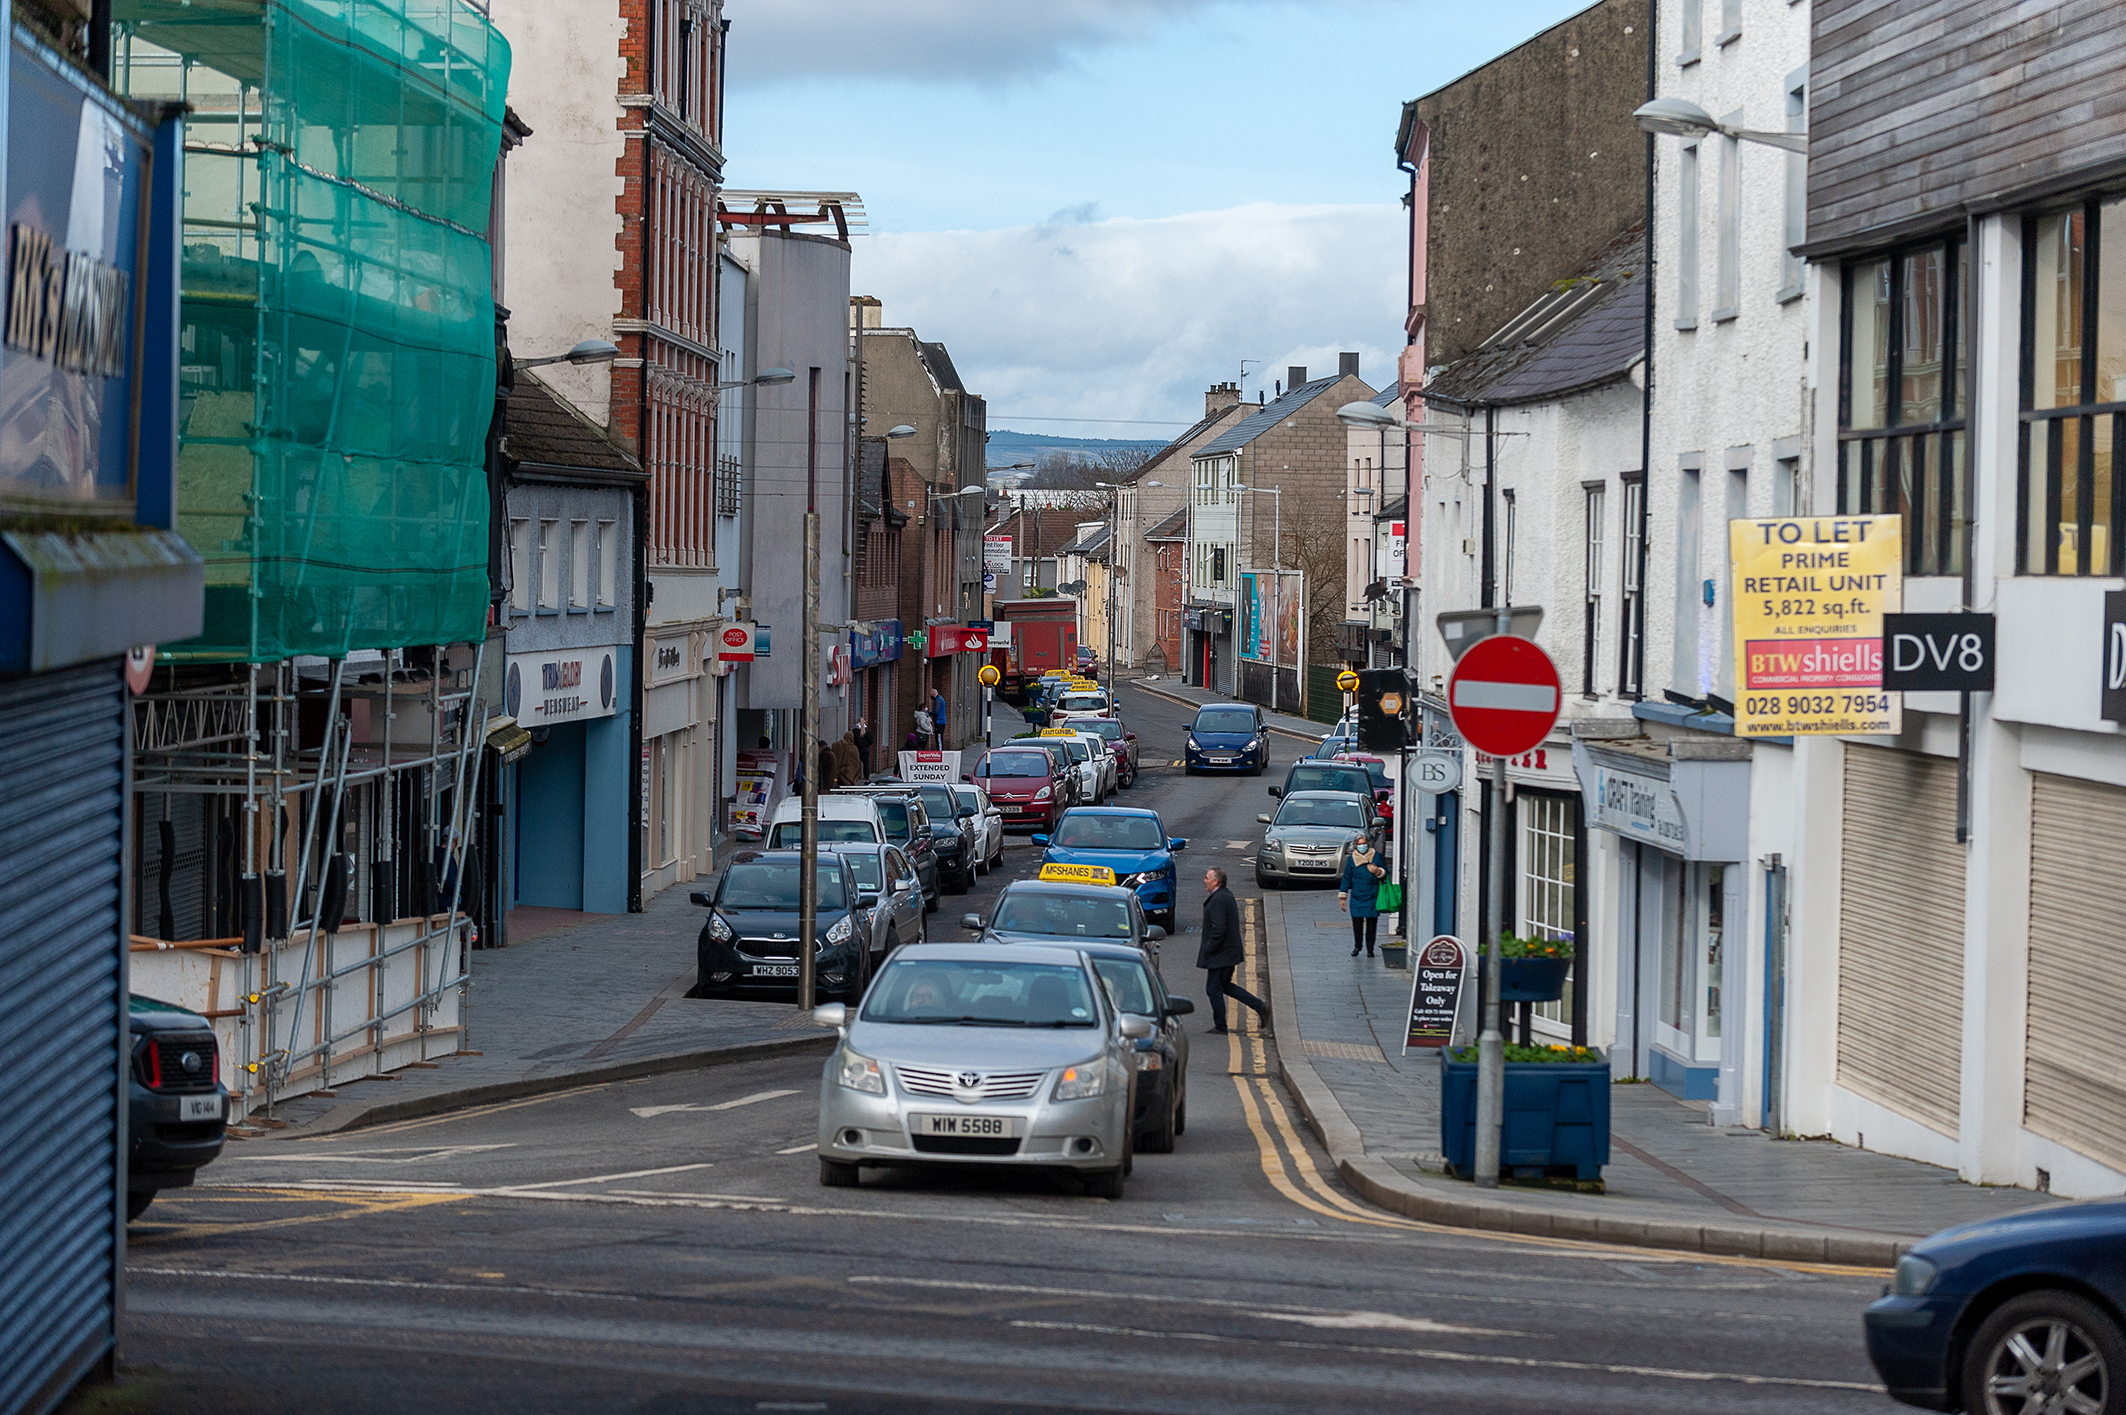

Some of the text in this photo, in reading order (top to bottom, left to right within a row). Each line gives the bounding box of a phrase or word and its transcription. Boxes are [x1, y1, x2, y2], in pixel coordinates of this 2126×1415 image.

[1757, 520, 1873, 545] TO LET
[1782, 551, 1850, 569] PRIME
[1744, 574, 1887, 593] RETAIL UNIT
[1763, 598, 1871, 619] 5,822 sq.ft.
[1774, 624, 1857, 635] ALL ENQUIRIES
[1751, 644, 1883, 674] BTWshiells
[1893, 633, 1985, 672] DV8
[1800, 674, 1834, 683] PROPERTY
[543, 696, 580, 715] MENSWEAR
[1746, 695, 1889, 715] 028 9032 7954
[1746, 719, 1890, 733] www.btwshiells.com
[1422, 764, 1446, 781] BS
[756, 966, 799, 976] WHZ 9053
[1422, 969, 1458, 981] Open for
[1420, 983, 1456, 995] Takeaway
[1425, 995, 1447, 1007] Only
[932, 1117, 1002, 1134] WIW 5588
